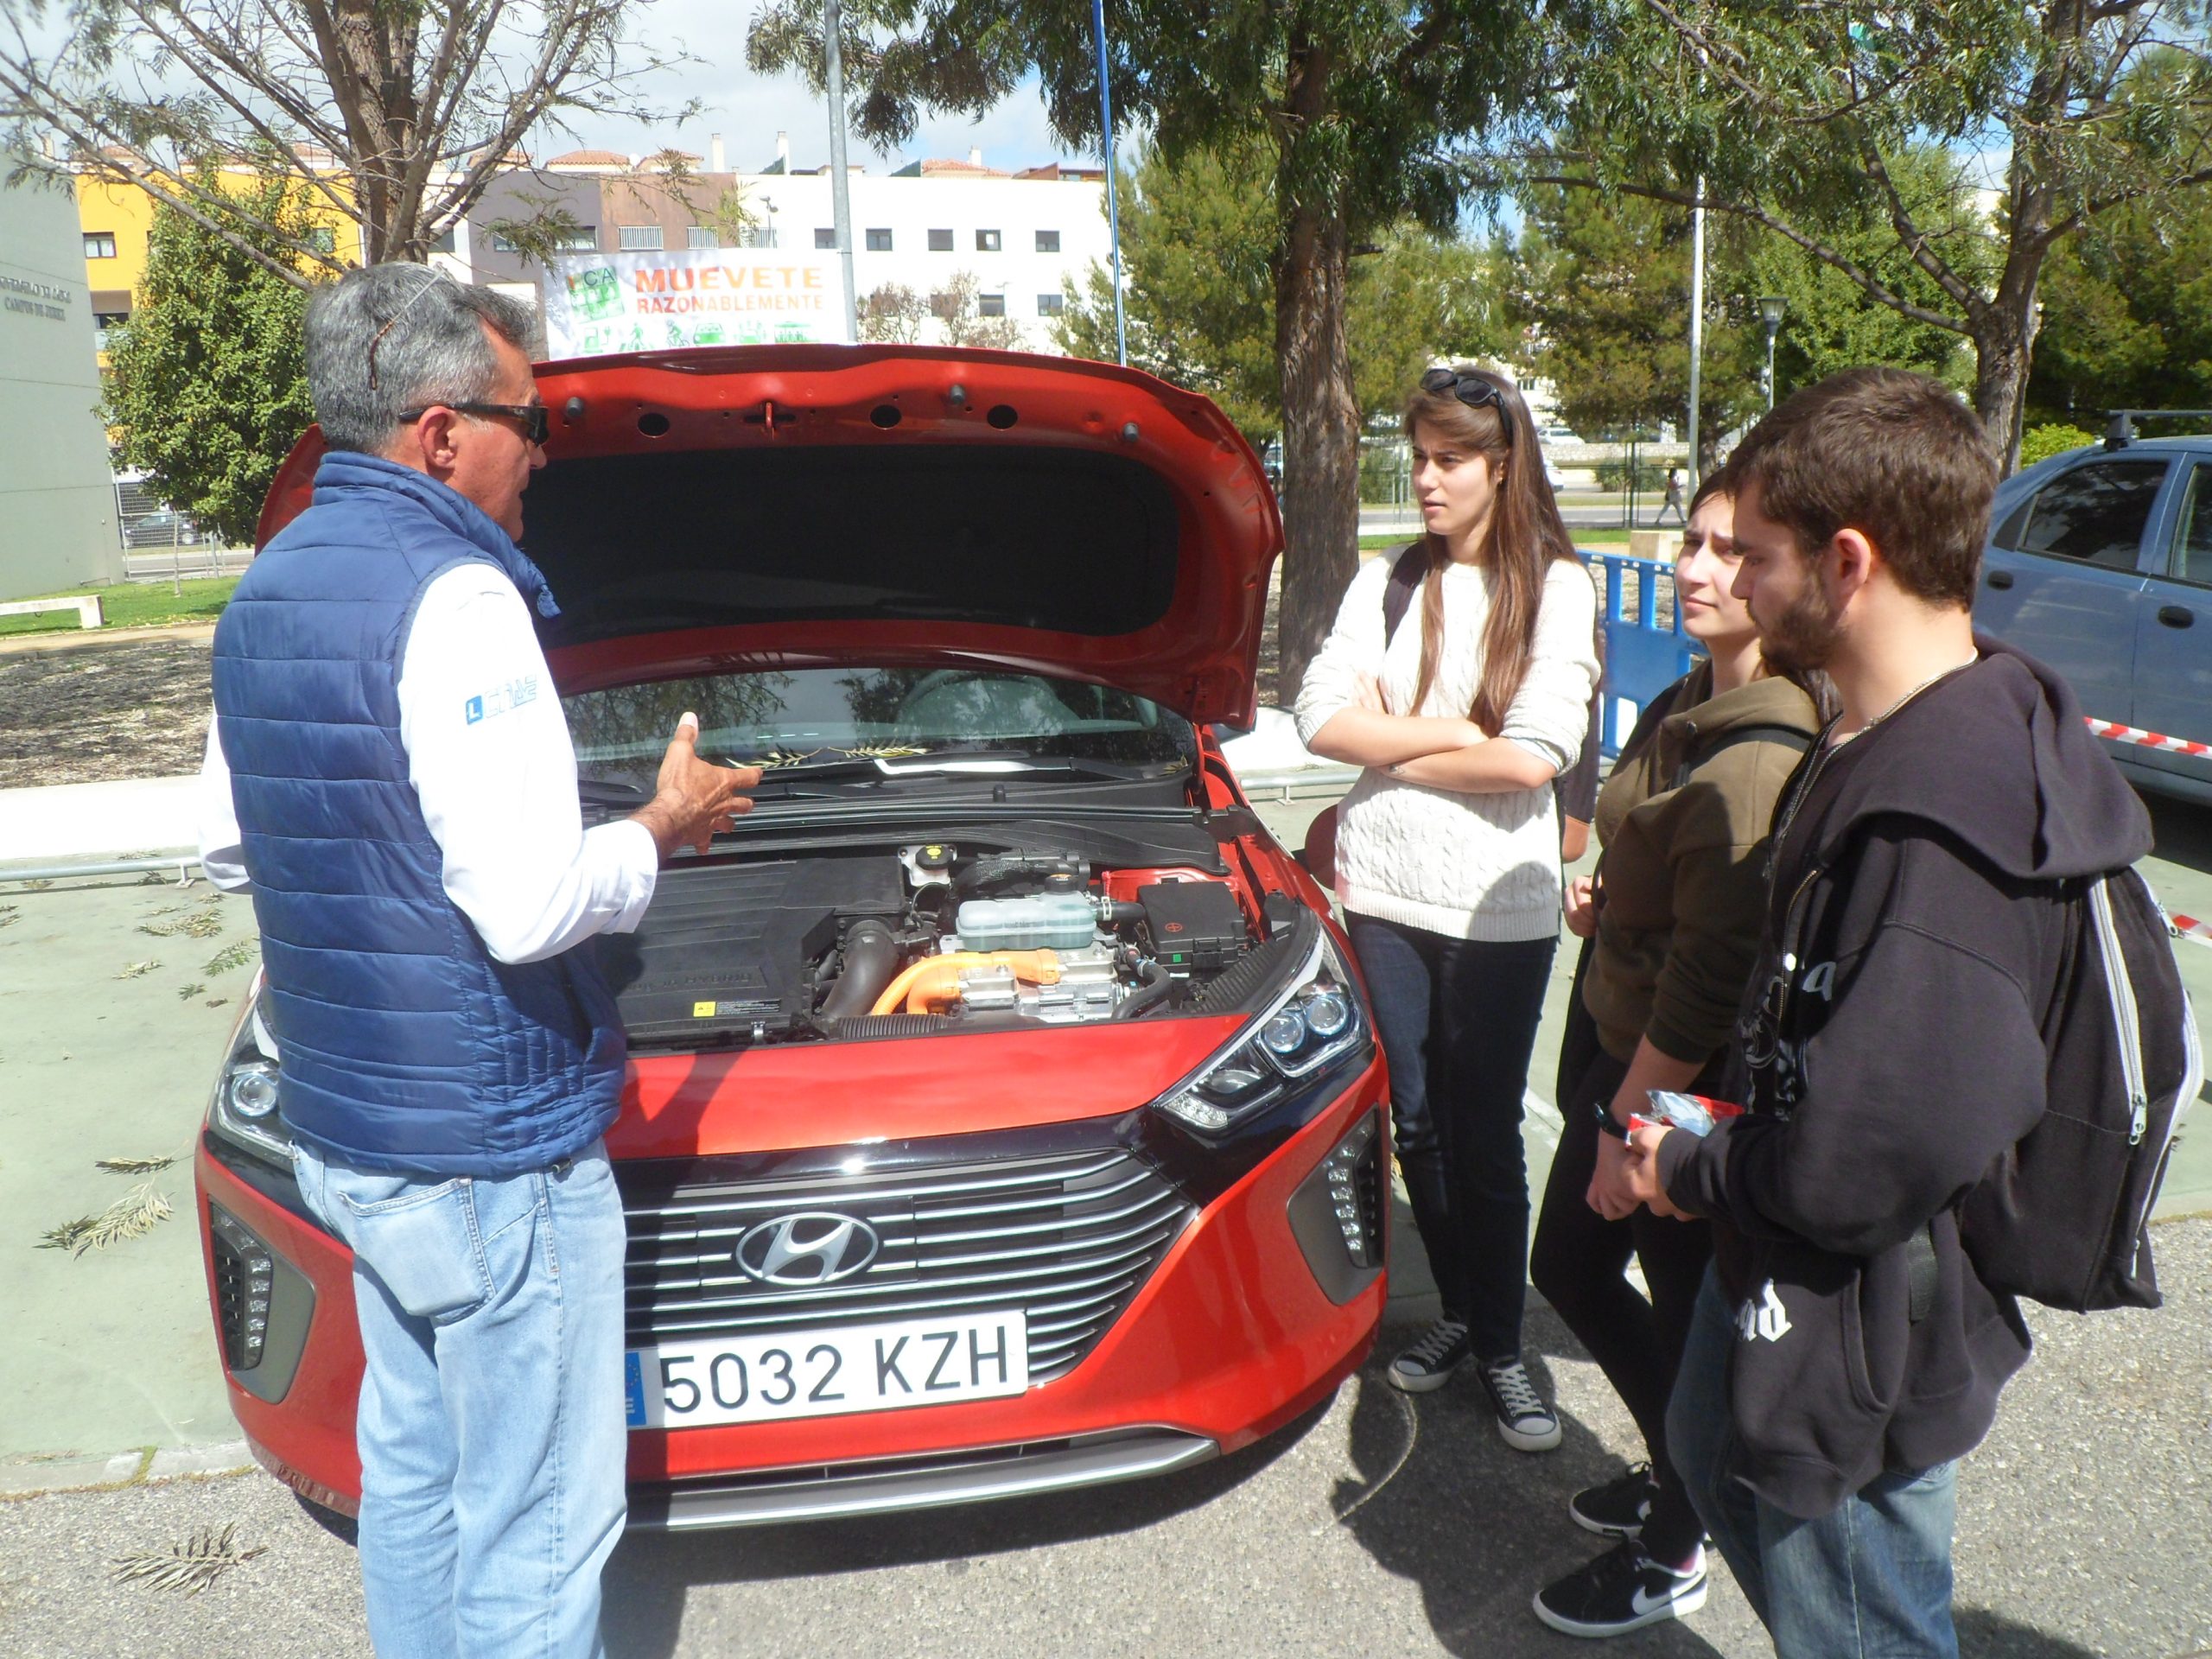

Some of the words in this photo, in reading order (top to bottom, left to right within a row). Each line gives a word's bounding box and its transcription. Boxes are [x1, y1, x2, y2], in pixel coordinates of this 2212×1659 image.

[634, 266, 823, 293] MUEVETE
[636, 295, 823, 315] RAZONABLEMENTE
[659, 1344, 846, 1414] 5032
[874, 1325, 1009, 1397] KZH
